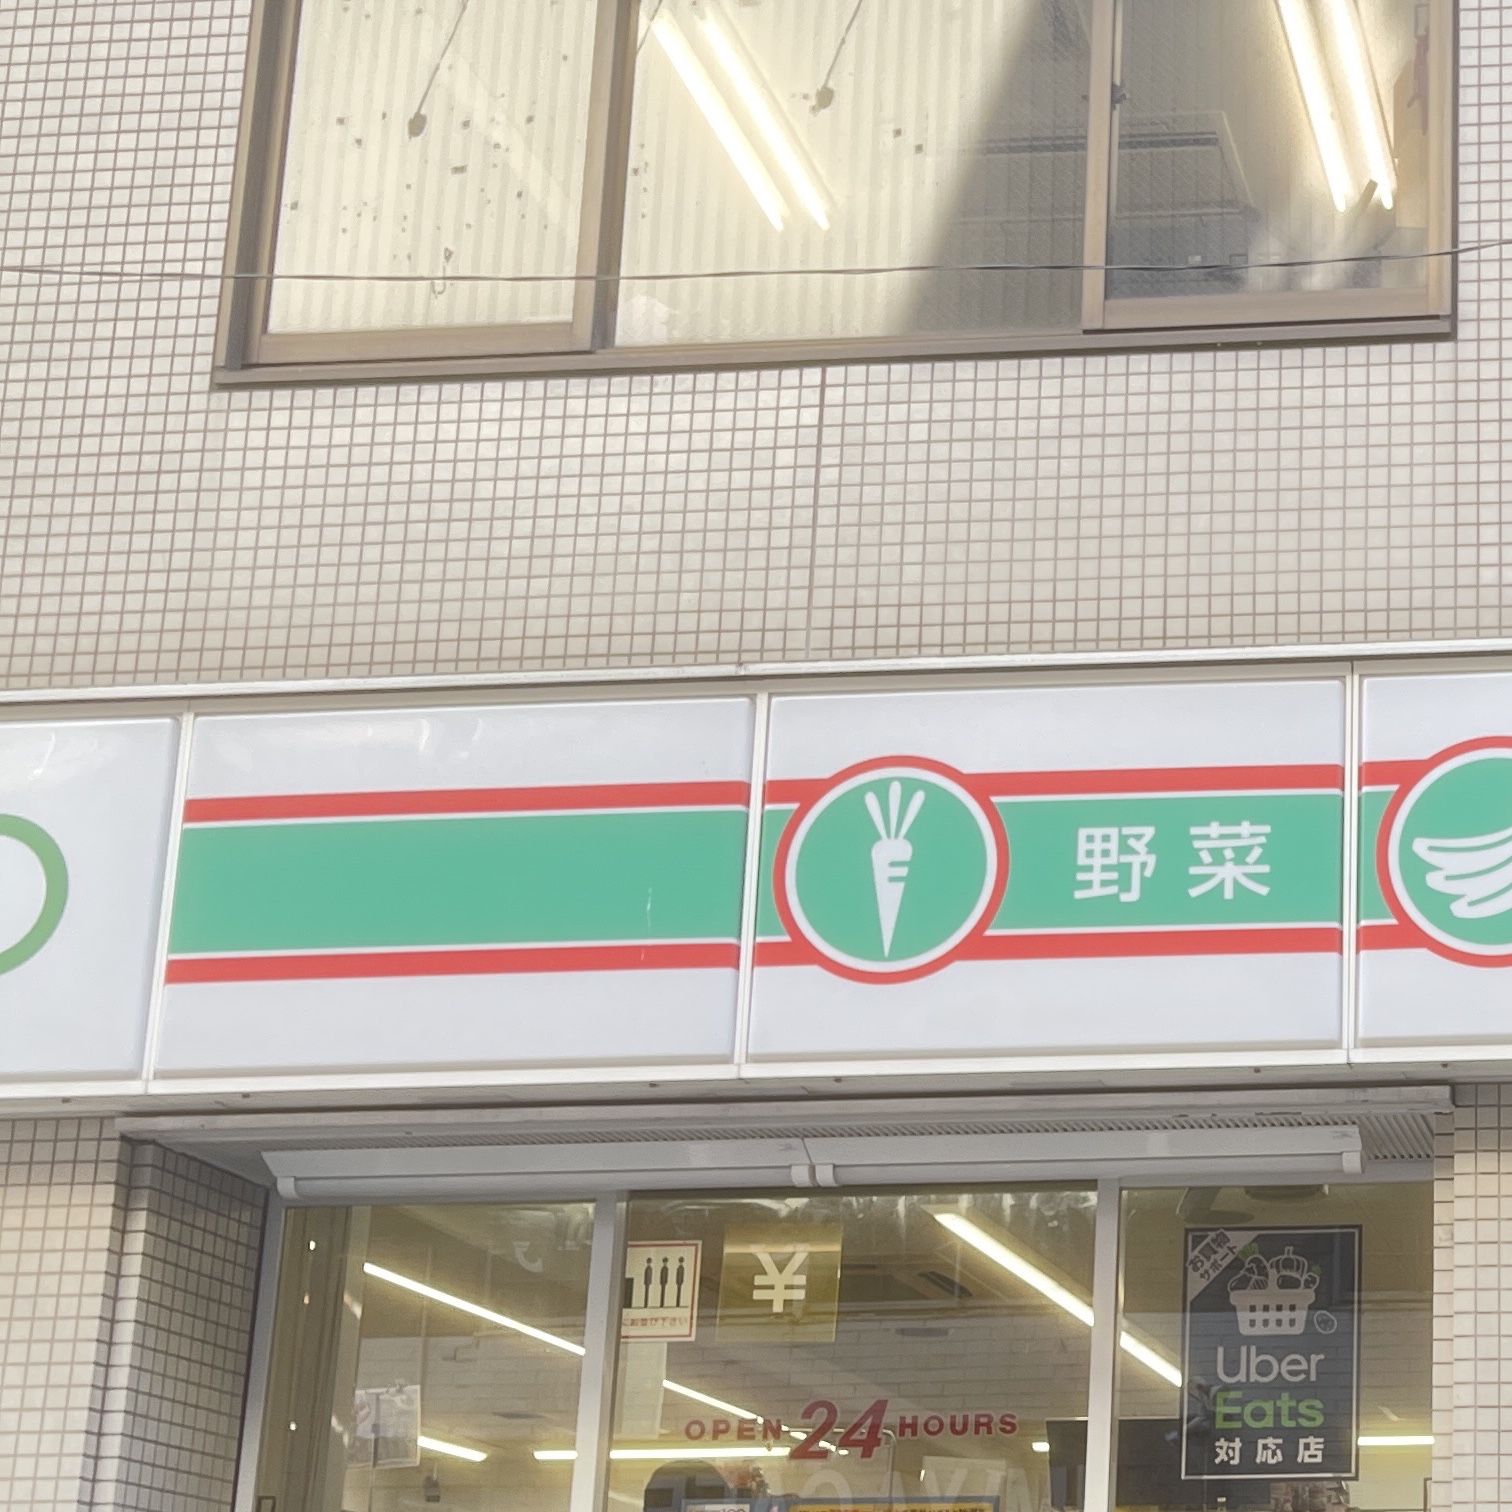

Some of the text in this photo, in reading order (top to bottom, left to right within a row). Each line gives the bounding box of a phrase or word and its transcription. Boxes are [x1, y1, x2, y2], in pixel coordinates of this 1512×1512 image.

[1074, 820, 1272, 902] 野菜
[1216, 1345, 1325, 1384] Uber
[685, 1399, 1018, 1460] OPEN 24 HOURS
[1215, 1391, 1325, 1429] Eats
[1214, 1436, 1325, 1466] 対応店
